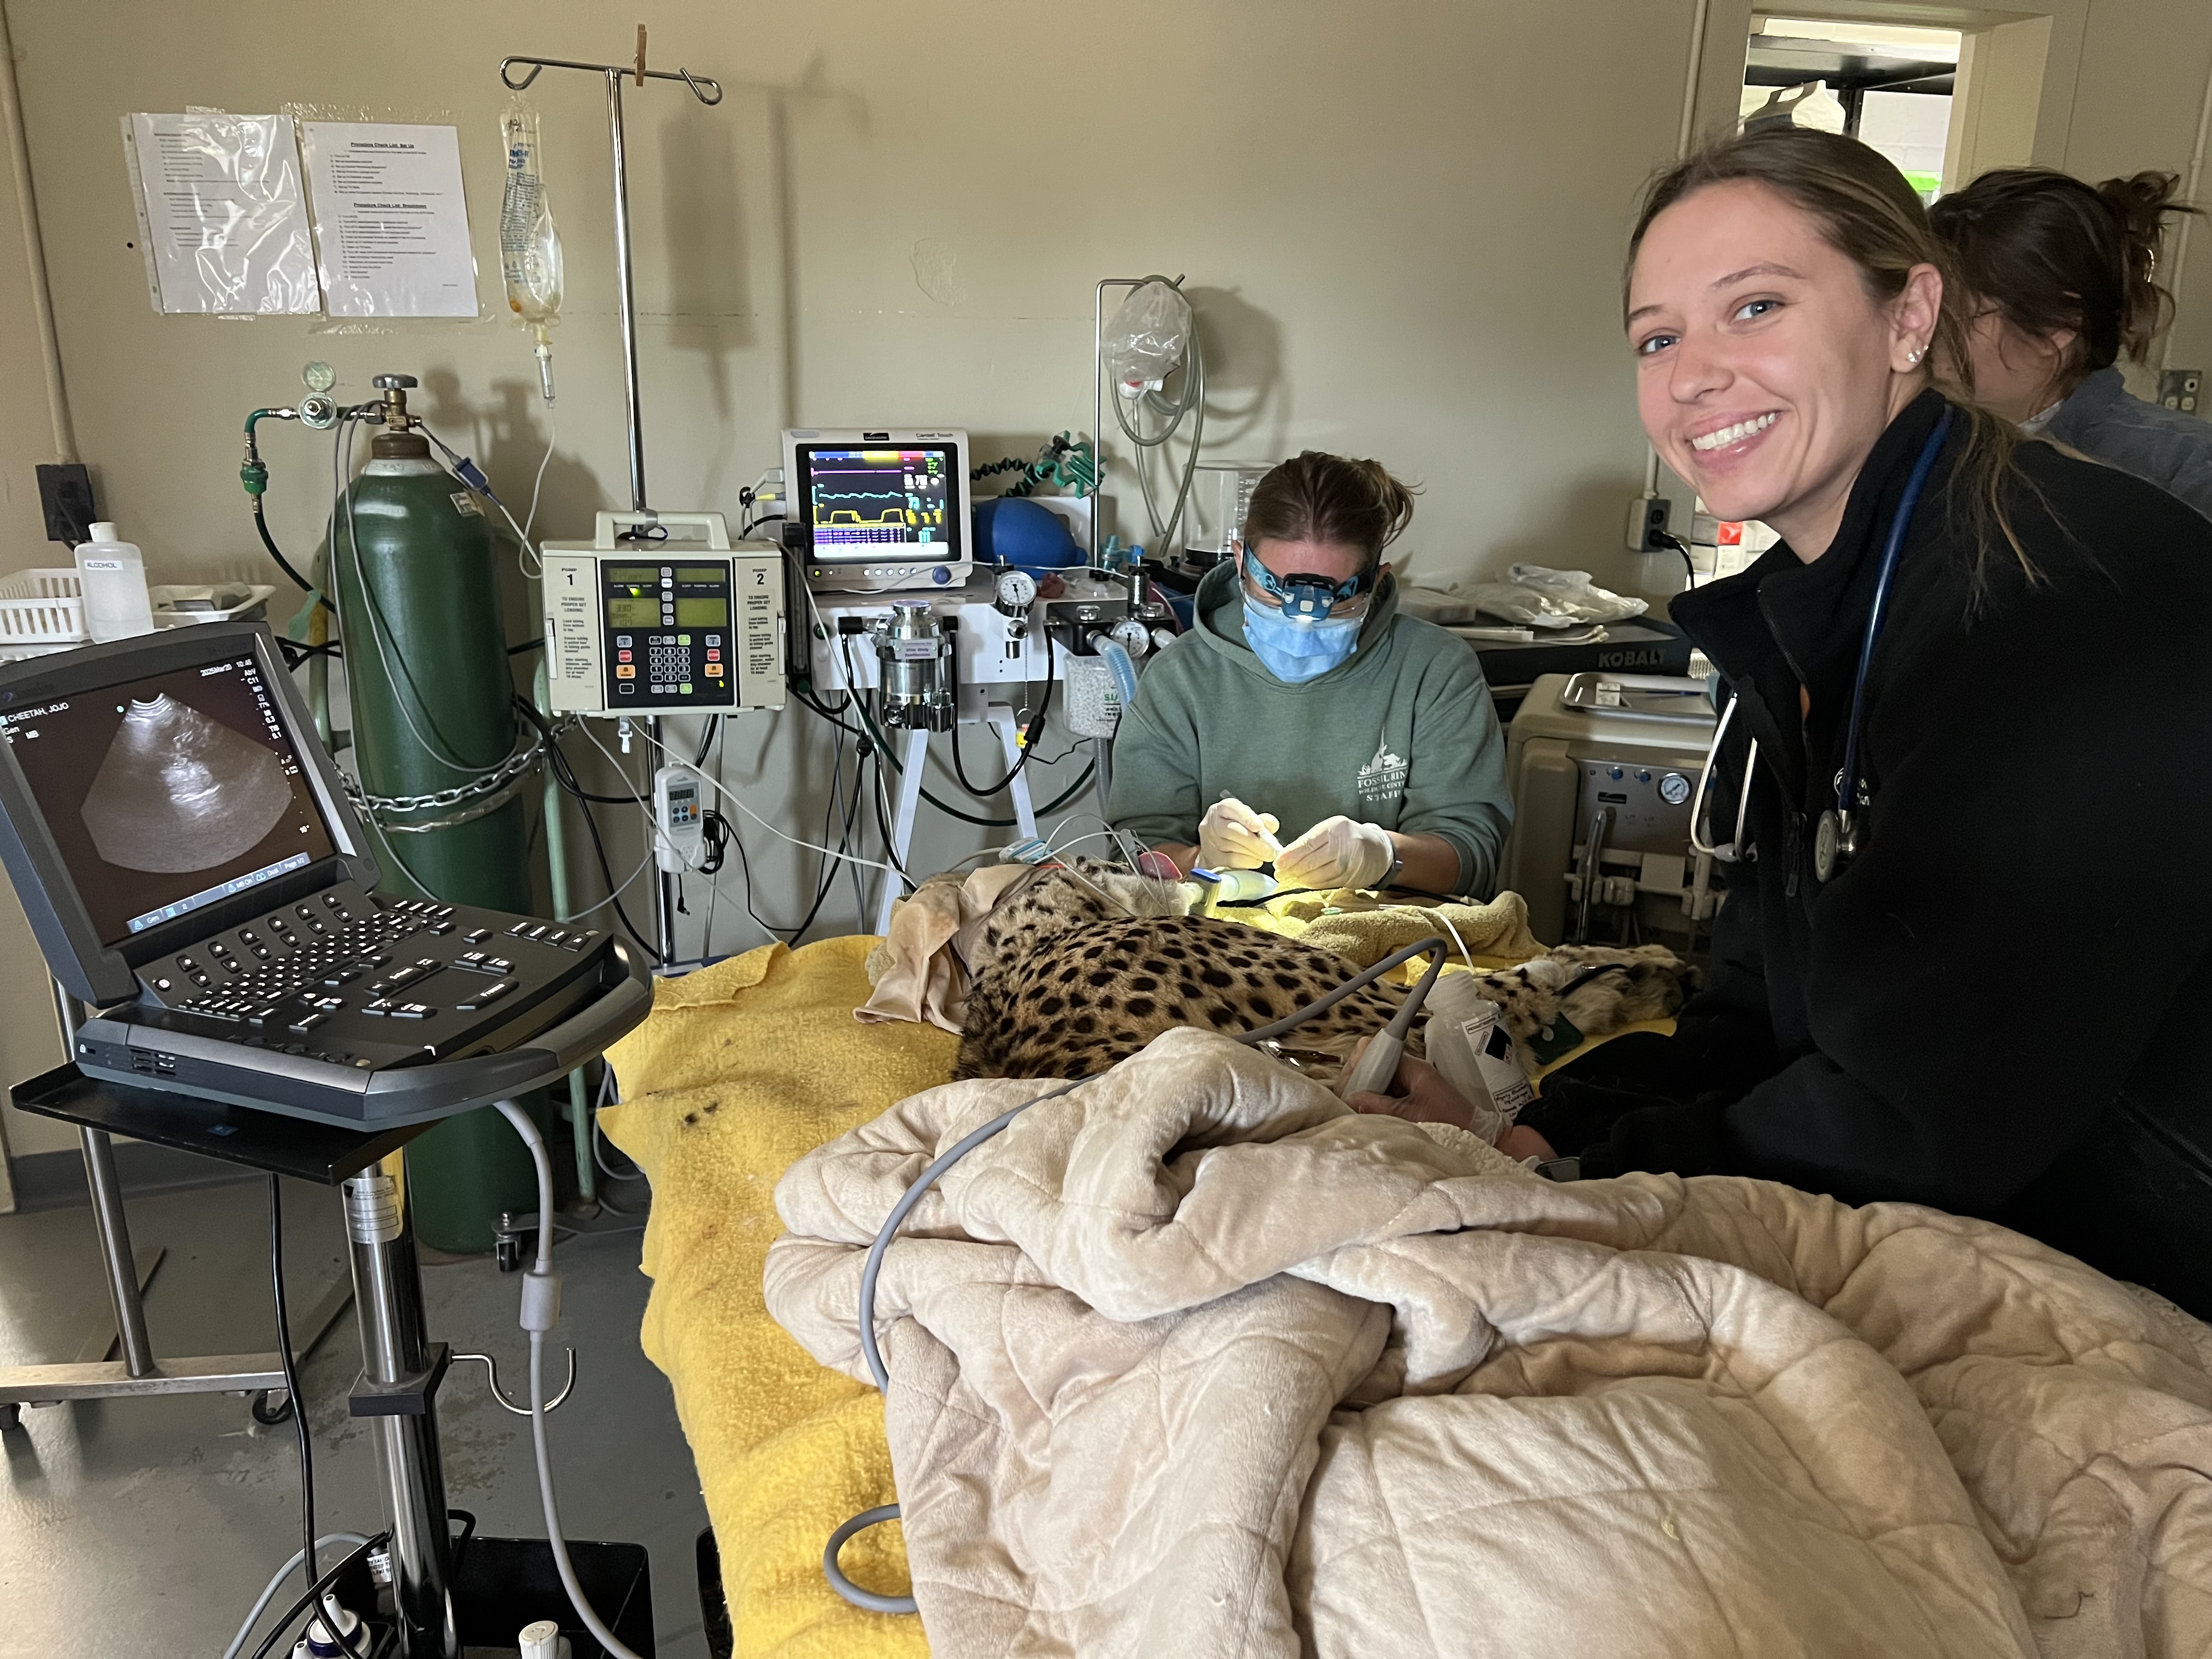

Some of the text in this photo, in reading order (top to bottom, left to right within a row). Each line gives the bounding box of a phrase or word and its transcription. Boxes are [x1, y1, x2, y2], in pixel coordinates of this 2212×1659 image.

[567, 574, 573, 585] 1
[757, 573, 764, 585] 2
[1598, 648, 1667, 668] KOBALT
[247, 676, 259, 685] C11
[7, 702, 69, 723] CHEETAH, JOJO
[4, 726, 20, 735] Gen
[25, 730, 40, 740] MB
[1358, 774, 1390, 788] FOSSIL
[1366, 790, 1401, 802] STAFF
[146, 915, 160, 923] Gen
[267, 867, 279, 877] Dual
[284, 860, 297, 870] Page
